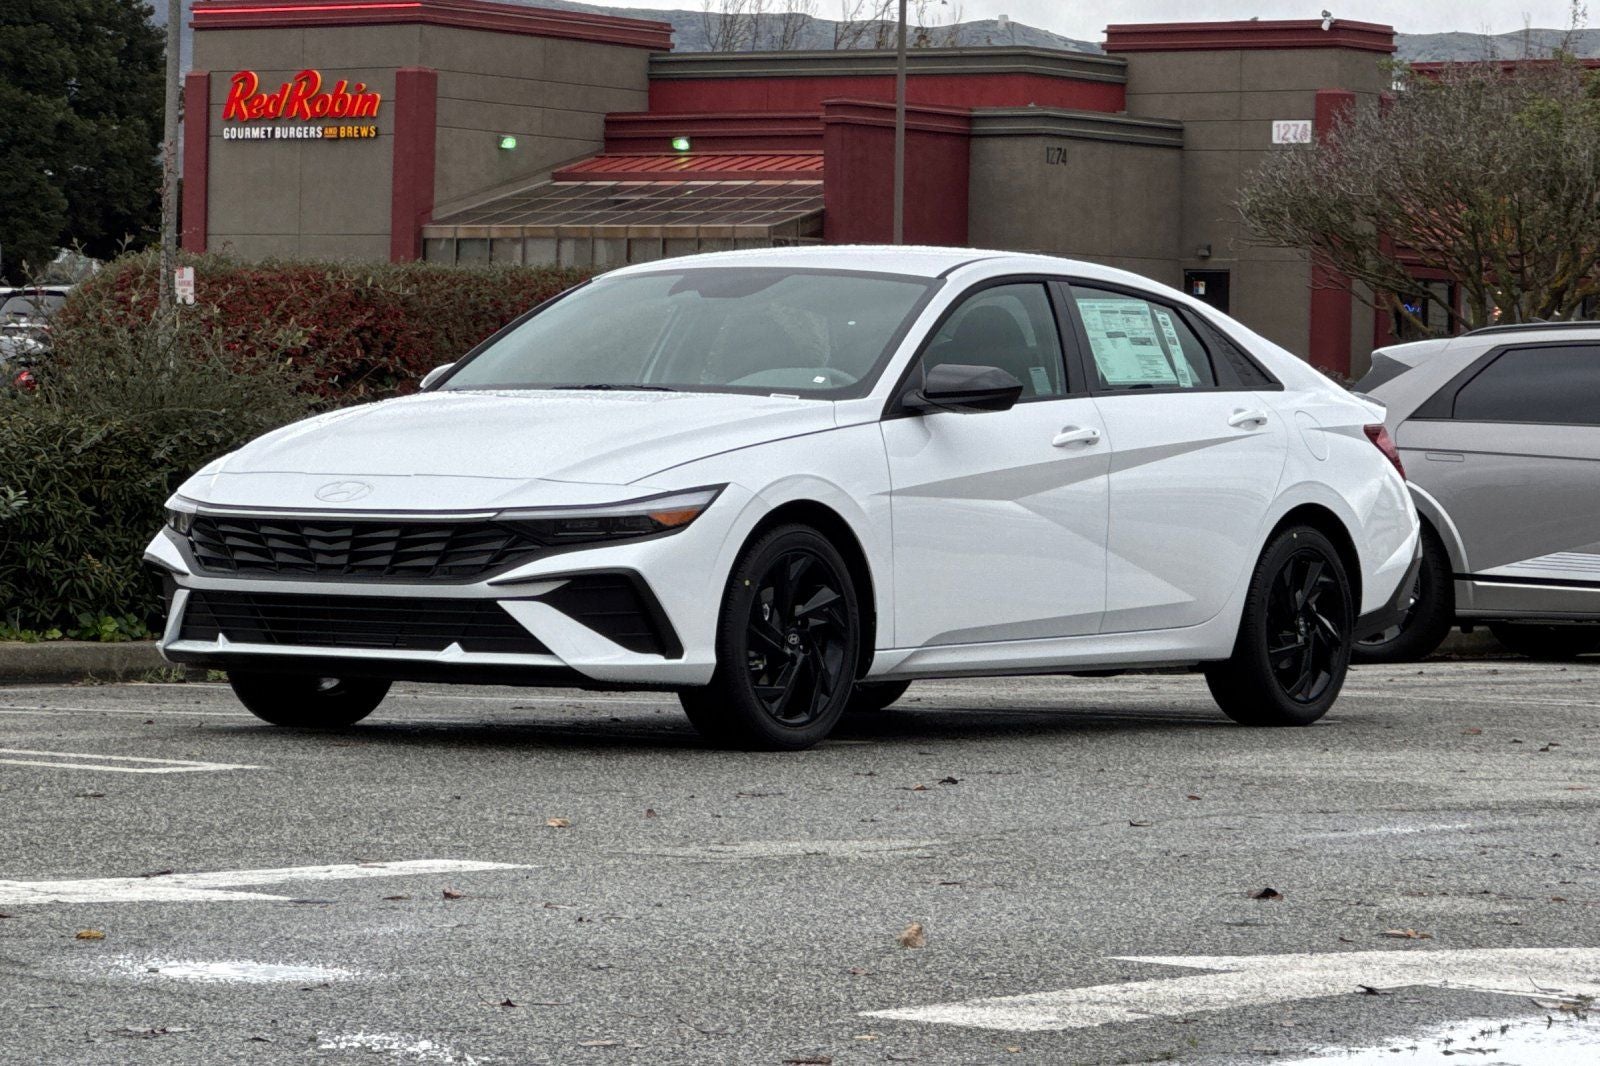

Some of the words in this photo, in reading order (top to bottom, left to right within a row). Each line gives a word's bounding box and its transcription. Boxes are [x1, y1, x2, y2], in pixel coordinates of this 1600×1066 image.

[222, 70, 292, 122] Red
[286, 69, 381, 122] Robin
[223, 127, 273, 140] GOURMET
[274, 126, 323, 139] BURGERS
[324, 127, 338, 138] AND
[339, 126, 376, 138] BREWS
[1046, 146, 1067, 166] 1274
